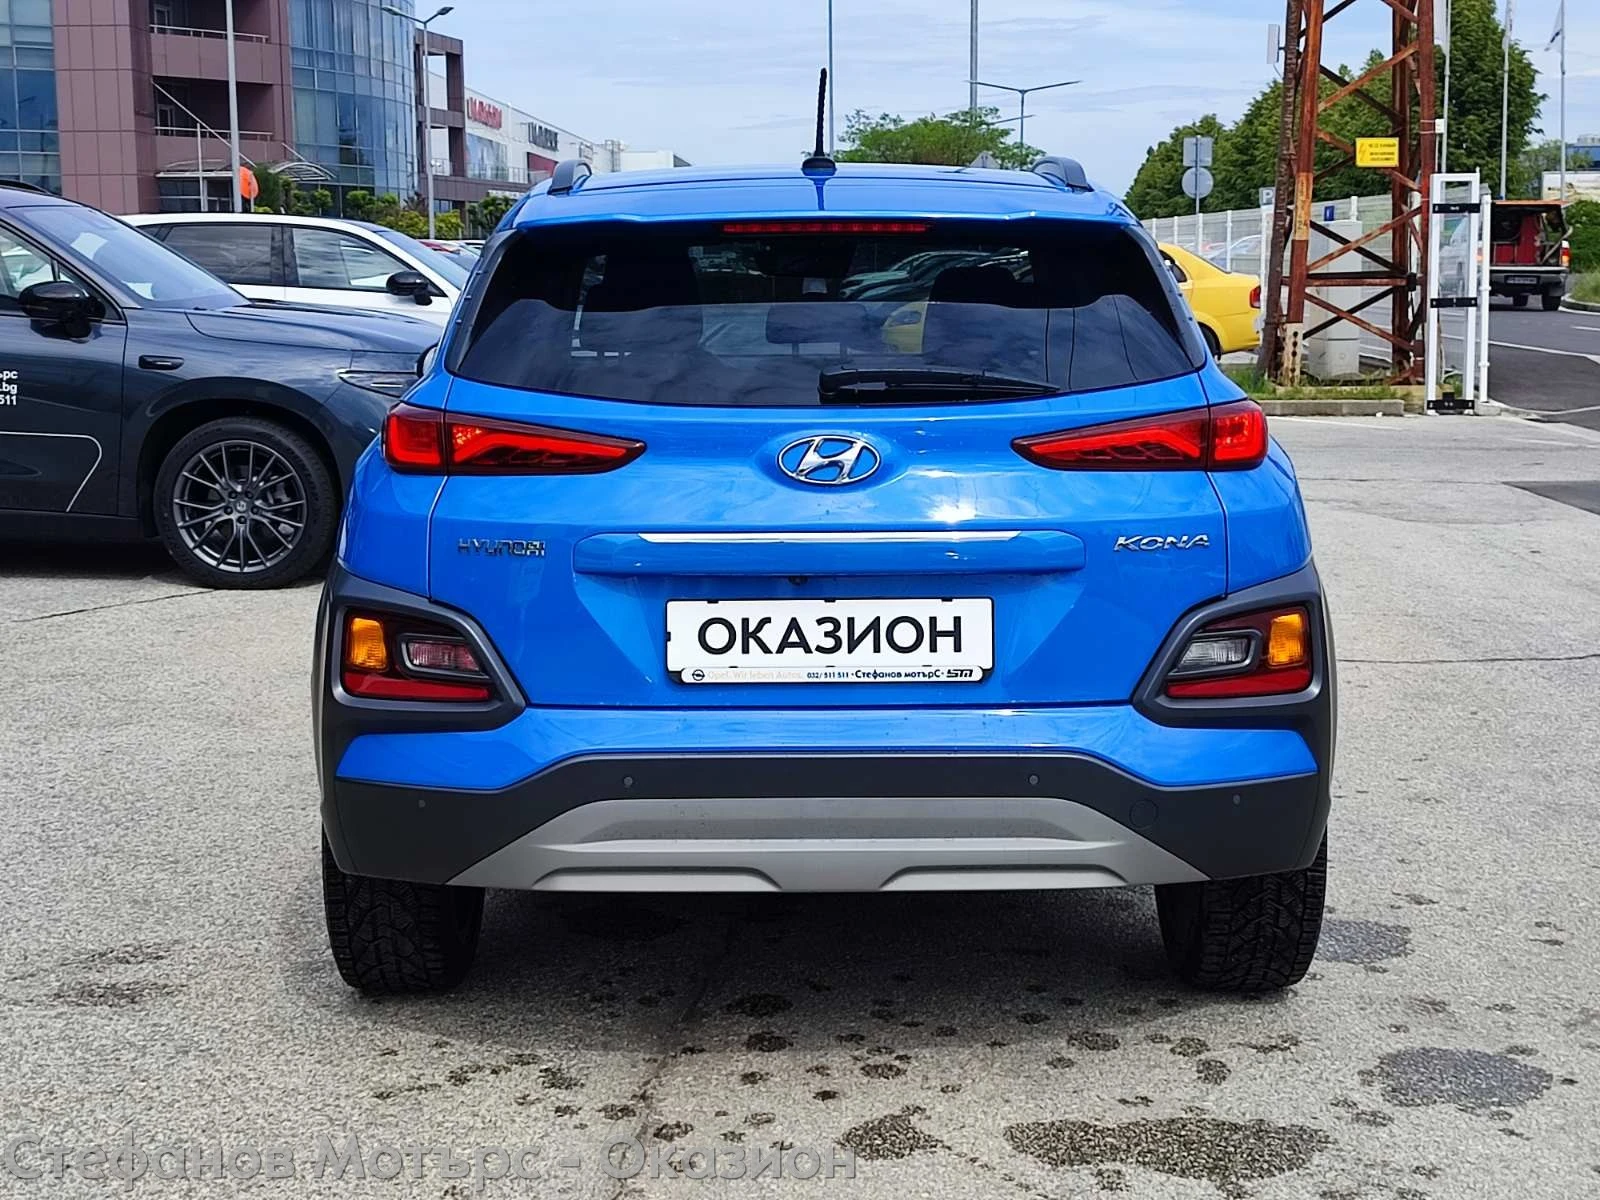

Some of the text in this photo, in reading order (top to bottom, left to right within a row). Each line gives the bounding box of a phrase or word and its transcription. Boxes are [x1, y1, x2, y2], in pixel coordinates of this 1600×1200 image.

[458, 538, 546, 557] HYUNDAI
[1113, 534, 1211, 551] KONA
[697, 616, 962, 655] ОКАЗИОН
[855, 669, 903, 680] Стефанов
